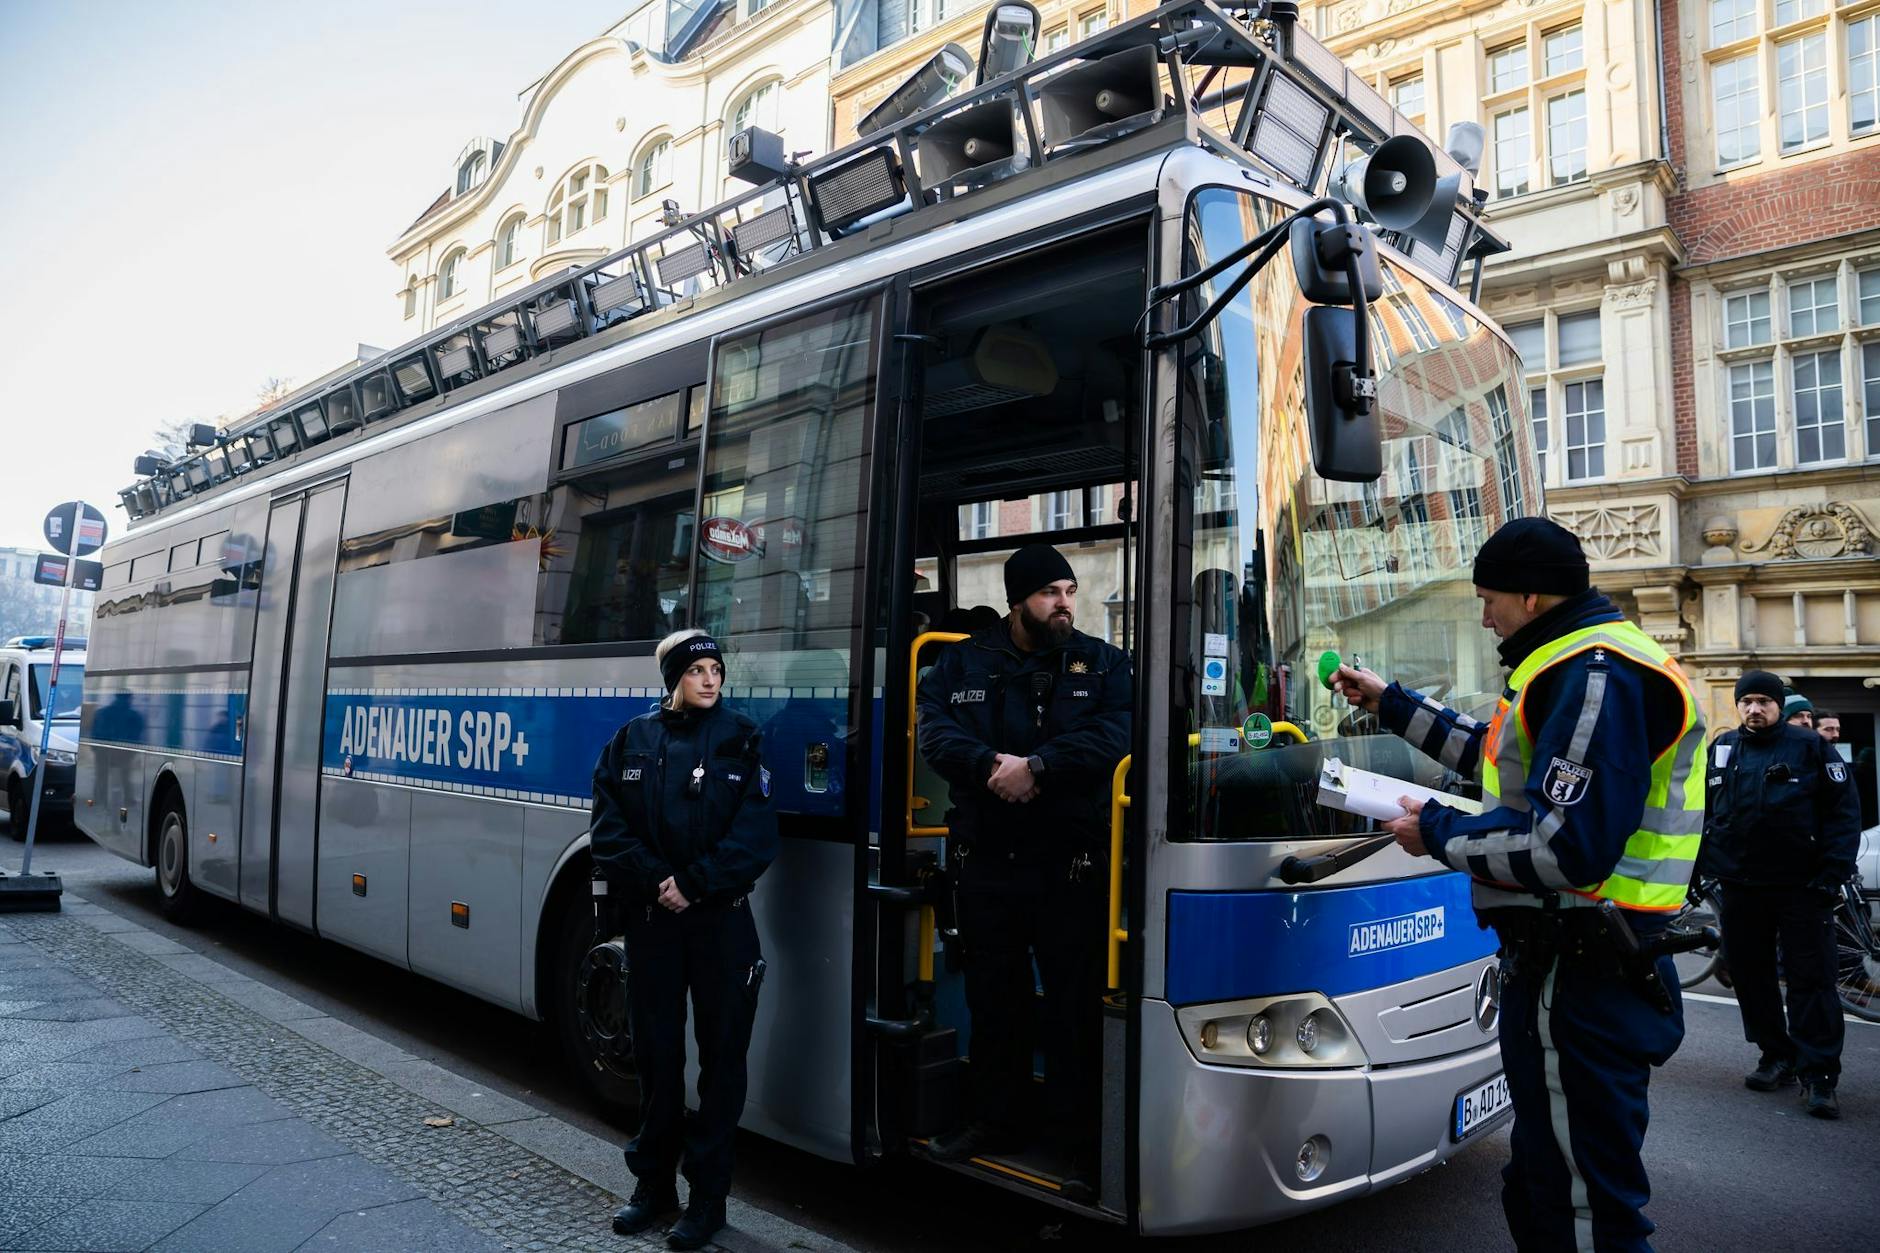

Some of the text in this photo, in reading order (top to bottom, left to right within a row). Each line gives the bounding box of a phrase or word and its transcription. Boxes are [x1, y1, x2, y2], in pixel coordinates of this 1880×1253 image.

[689, 642, 717, 652] POLIZE
[950, 689, 986, 704] POLIZEI
[1253, 715, 1262, 730] 4
[339, 706, 529, 772] ADENAUER SRP+
[622, 768, 642, 781] LIZEI
[1552, 760, 1590, 779] POLIZEI
[1350, 913, 1443, 953] ADENAUER SRP+
[1464, 1097, 1472, 1127] B
[1480, 1084, 1495, 1117] AD
